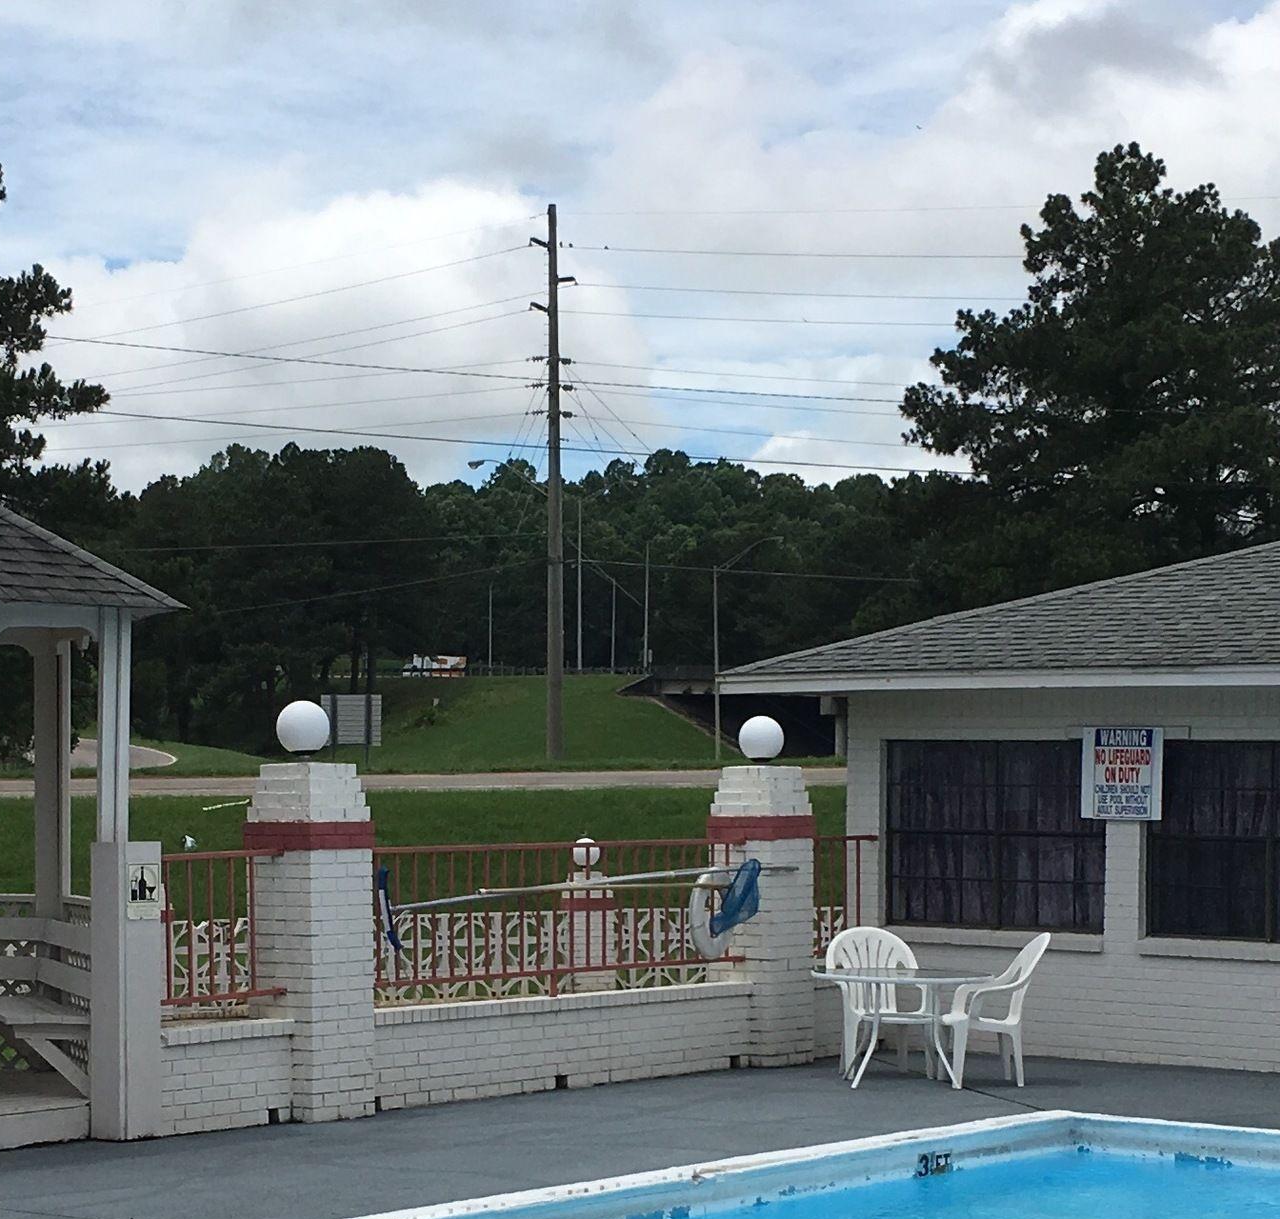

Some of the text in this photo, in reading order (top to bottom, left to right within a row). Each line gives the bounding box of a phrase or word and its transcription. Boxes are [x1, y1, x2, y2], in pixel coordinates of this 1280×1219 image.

[1099, 729, 1148, 746] WARNING
[1095, 748, 1151, 765] NO LIFEGUARD
[1104, 767, 1140, 783] ON DUTY
[917, 1154, 930, 1177] 3
